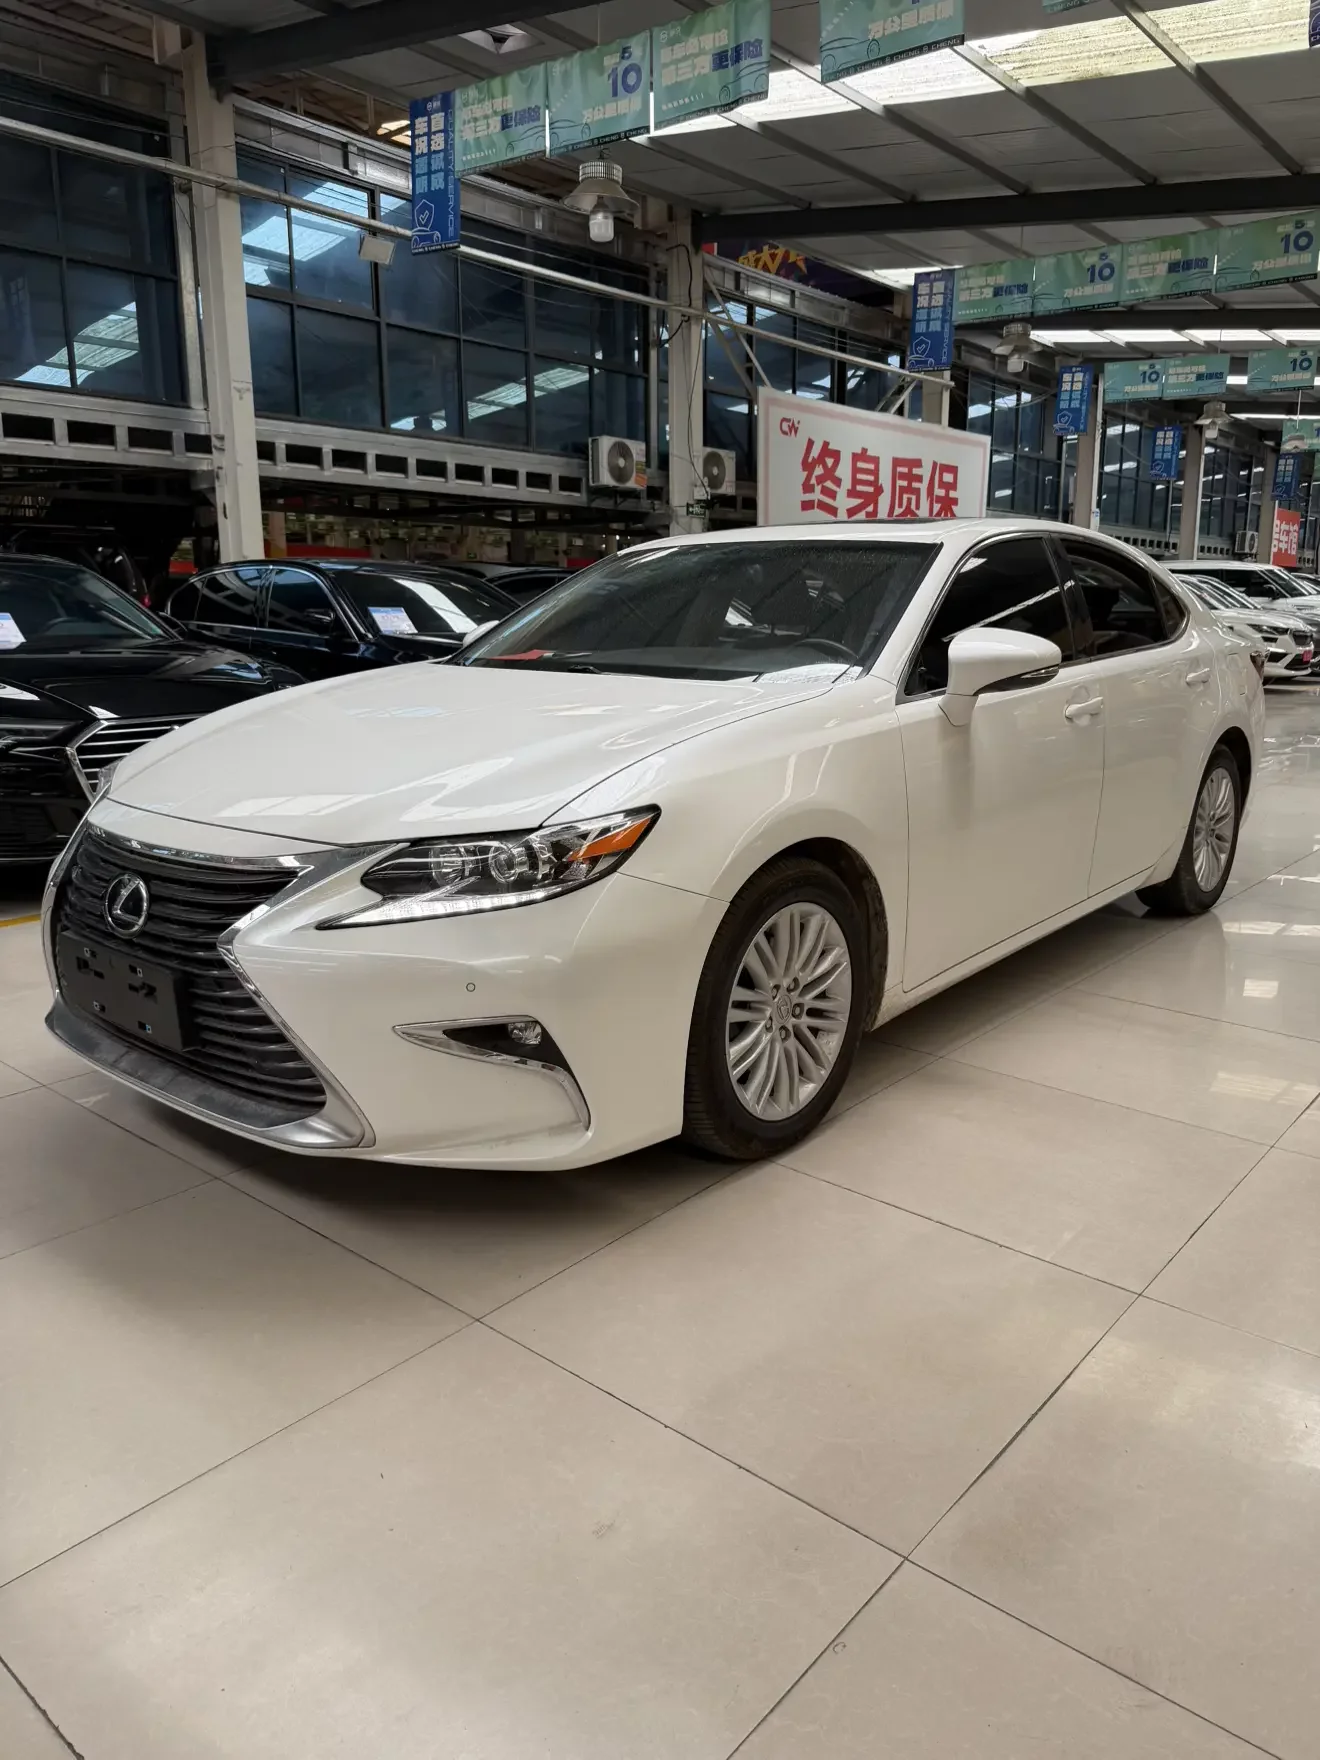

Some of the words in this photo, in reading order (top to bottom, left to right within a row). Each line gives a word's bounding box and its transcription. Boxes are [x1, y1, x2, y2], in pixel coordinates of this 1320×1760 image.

[608, 63, 642, 98] 10
[1280, 230, 1314, 254] 10
[1087, 262, 1115, 283] 10
[1290, 357, 1312, 371] 10
[1140, 370, 1160, 383] 10
[800, 437, 959, 519] 终身质保
